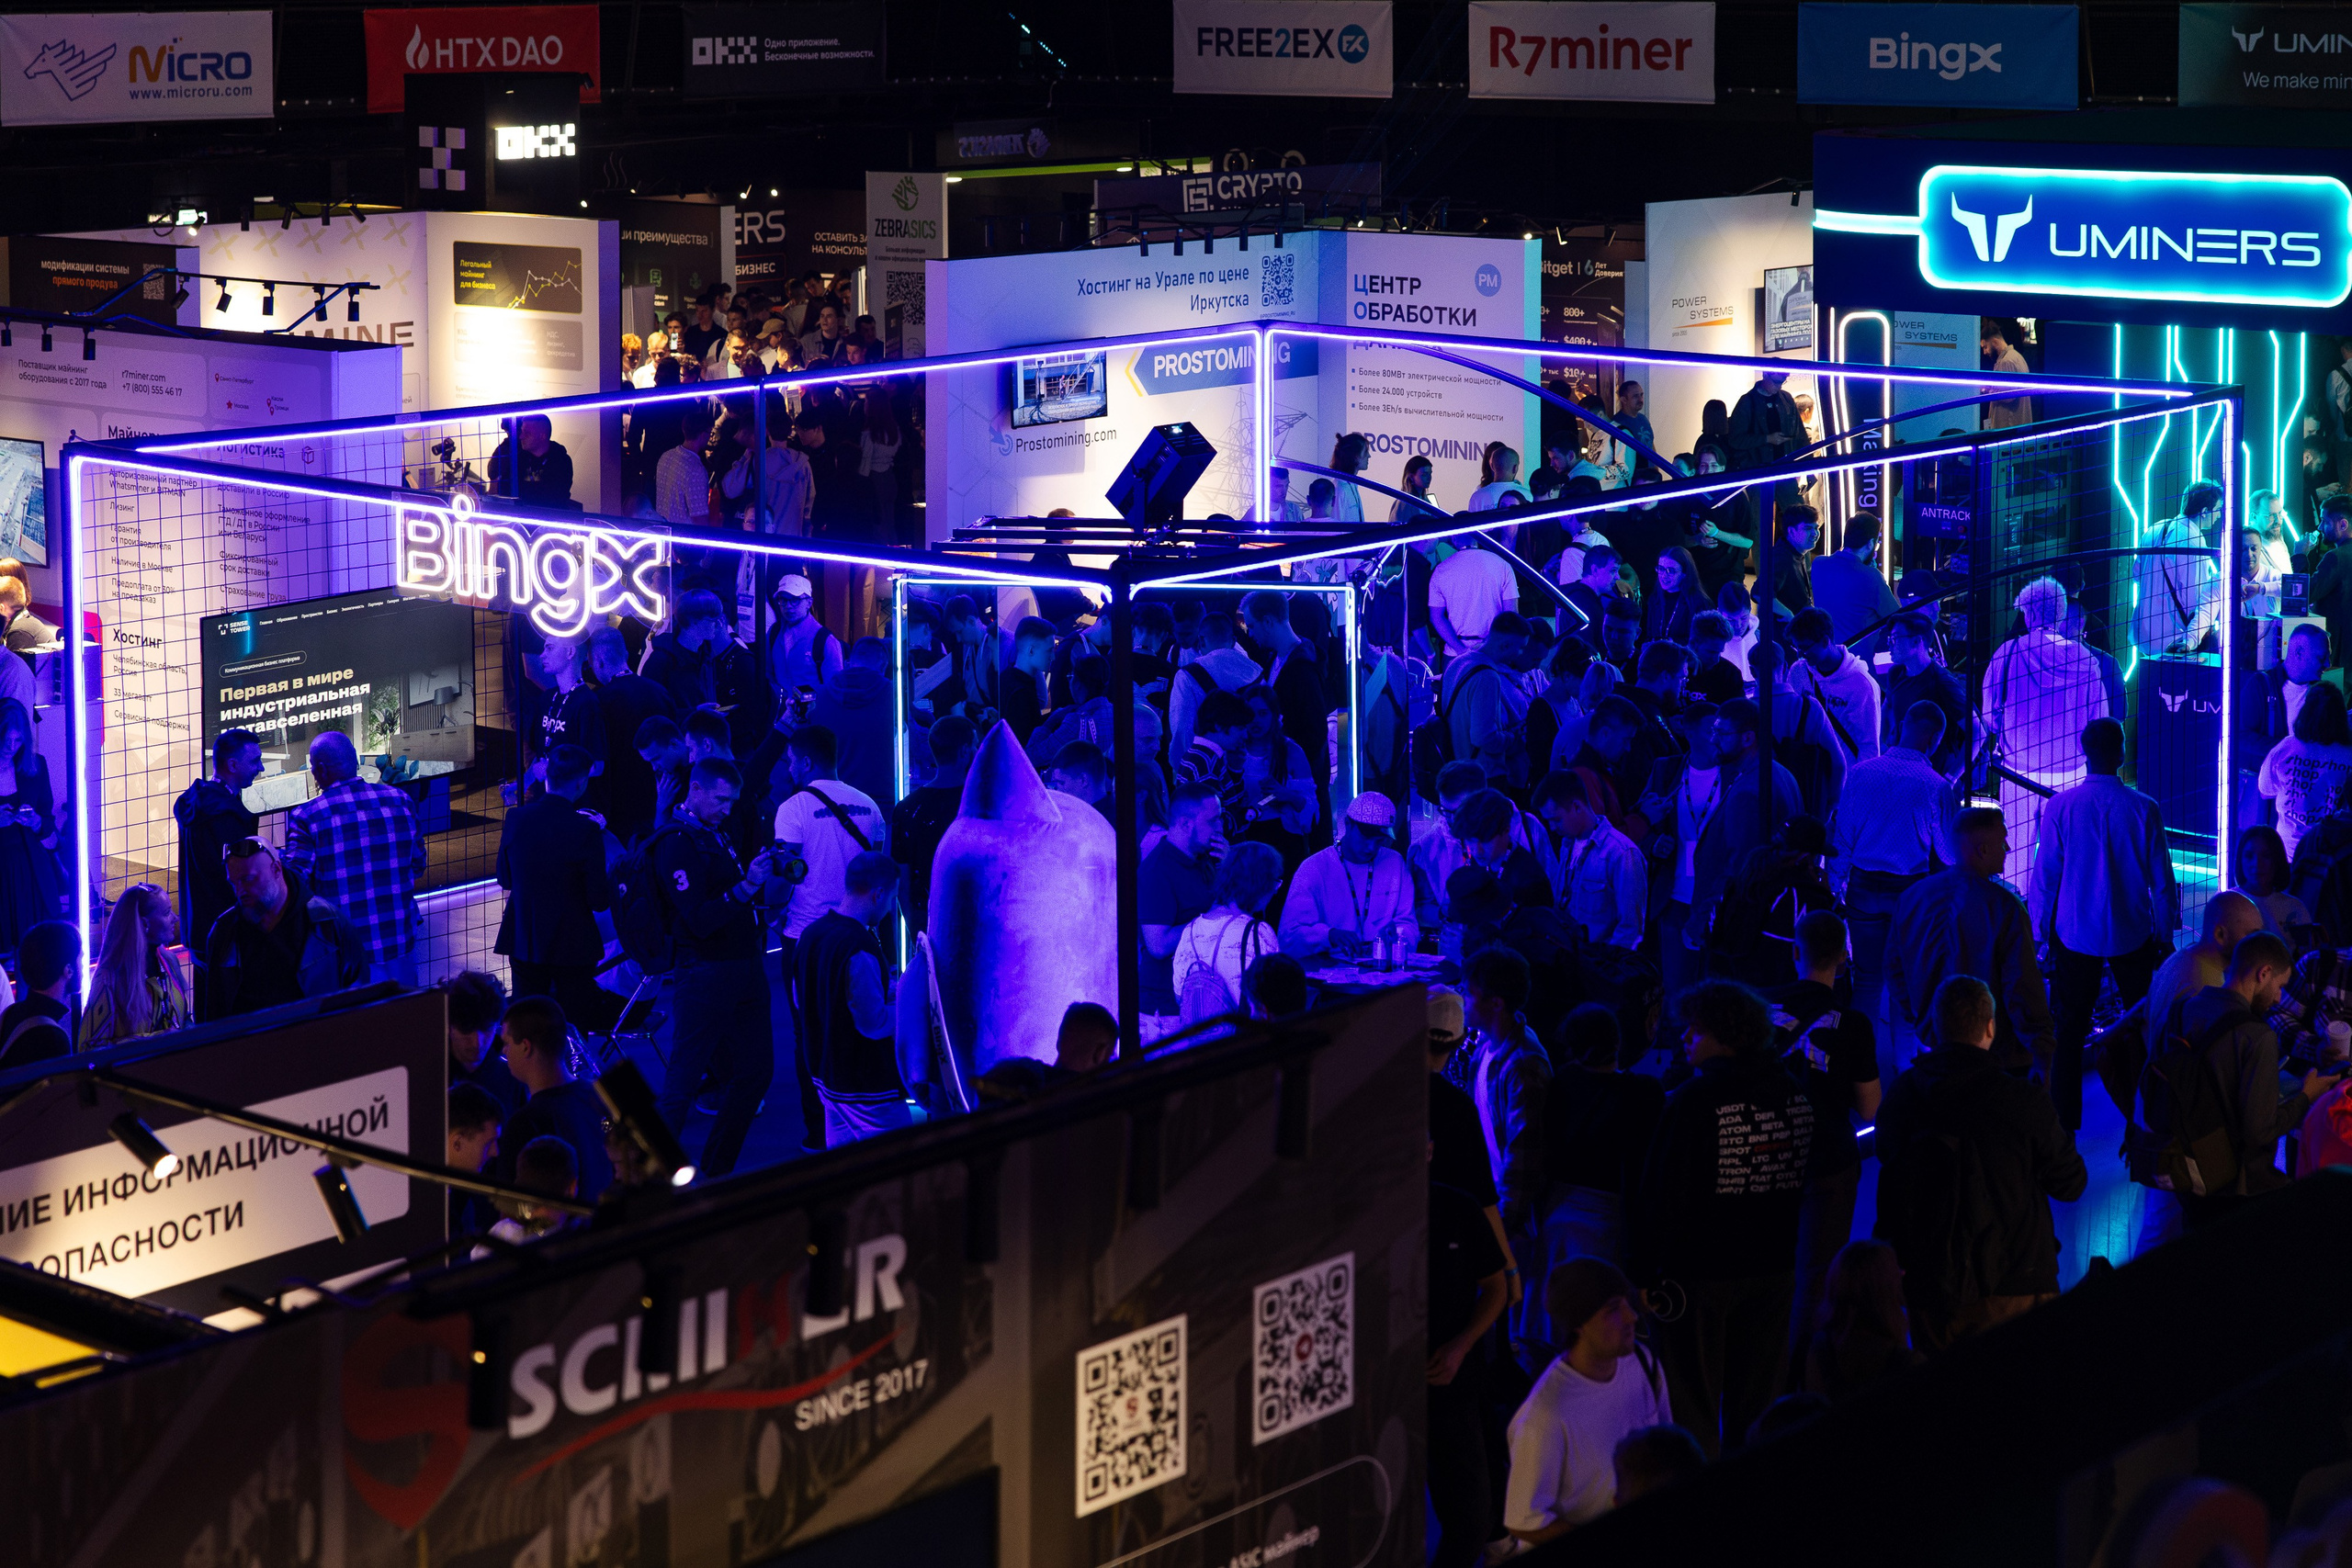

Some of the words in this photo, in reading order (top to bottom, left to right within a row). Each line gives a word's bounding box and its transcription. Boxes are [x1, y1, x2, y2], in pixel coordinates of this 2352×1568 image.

[692, 36, 758, 66] OKX
[764, 38, 787, 50] Одно
[788, 37, 842, 50] приложение.
[1197, 27, 1335, 59] FREE2EX
[1489, 24, 1693, 76] R7miner
[435, 38, 496, 69] HTX
[503, 35, 564, 67] DAO
[764, 51, 820, 62] Бесконечные
[820, 50, 876, 61] возможности.
[2243, 71, 2270, 88] We
[2276, 72, 2319, 89] make
[129, 84, 254, 100] www.microru.com
[495, 123, 576, 160] OKX
[1216, 171, 1303, 200] CRYPTO
[814, 231, 858, 243] ОСТАВИТЬ
[875, 218, 936, 240] ZEBRASICS
[633, 231, 708, 246] преимущества
[2049, 222, 2322, 267] UMINERS
[811, 244, 823, 254] НА
[40, 260, 95, 273] модификации
[96, 263, 130, 275] системы
[735, 262, 775, 276] БИЗНЕС
[52, 276, 85, 288] прямого
[85, 277, 119, 290] продува
[1077, 278, 1132, 297] Хостинг
[1135, 277, 1151, 290] на
[1155, 271, 1195, 291] Урале
[1198, 271, 1215, 284] по
[1218, 267, 1250, 283] цене
[1353, 274, 1422, 296] ЦЕНТР
[1477, 274, 1498, 288] PM
[1190, 294, 1250, 314] Иркутска
[1672, 296, 1707, 309] POWER
[1353, 300, 1477, 327] ОБРАБОТКИ
[1563, 307, 1586, 318] 800+
[1690, 306, 1734, 320] SYSTEMS
[1894, 320, 1925, 330] OWER
[288, 321, 414, 348] INE
[1905, 331, 1958, 342] SYSTEMS
[18, 358, 56, 372] Поставщик
[58, 366, 88, 375] майнинг
[1154, 341, 1291, 378] PROSTOMING
[18, 372, 68, 385] оборудования
[74, 378, 89, 387] 2017
[91, 379, 107, 389] года
[121, 369, 166, 382] r7miner.com
[1359, 367, 1381, 378] Более
[1382, 369, 1406, 379] 80МВт
[1408, 372, 1463, 384] электрической
[1464, 377, 1502, 387] мощности
[131, 382, 150, 395] (800)
[151, 385, 164, 394] 555
[164, 387, 175, 395] 46
[175, 388, 183, 397] 17
[1359, 385, 1381, 395] Более
[1382, 387, 1405, 397] 24.000
[1406, 390, 1443, 400] устройств
[1359, 402, 1381, 412] Более
[1382, 404, 1403, 414] 3Eh/s
[1404, 407, 1464, 420] вычислительной
[1466, 412, 1505, 423] мощности
[107, 424, 160, 441] Майн
[1015, 429, 1117, 453] Prostomining.com
[1352, 432, 1487, 461] ROSTOMININ
[109, 468, 167, 483] Авторизованный
[168, 477, 198, 488] партнёр
[109, 502, 135, 513] Лизинг
[218, 503, 263, 518] Таможенное
[1921, 507, 1971, 522] ANTRACK
[111, 556, 141, 568] Наличие
[219, 550, 278, 566] Фиксированный
[111, 577, 153, 591] Предоплата
[220, 583, 266, 600] Страхование
[113, 628, 163, 649] Хостинг
[220, 681, 288, 703] Первая
[292, 677, 304, 690] в
[306, 668, 355, 687] мире
[220, 682, 371, 722] индустриальная
[33, 1200, 243, 1280] ОПАСНОСТИ
[794, 1381, 871, 1432] SINCE
[875, 1359, 929, 1404] 2017
